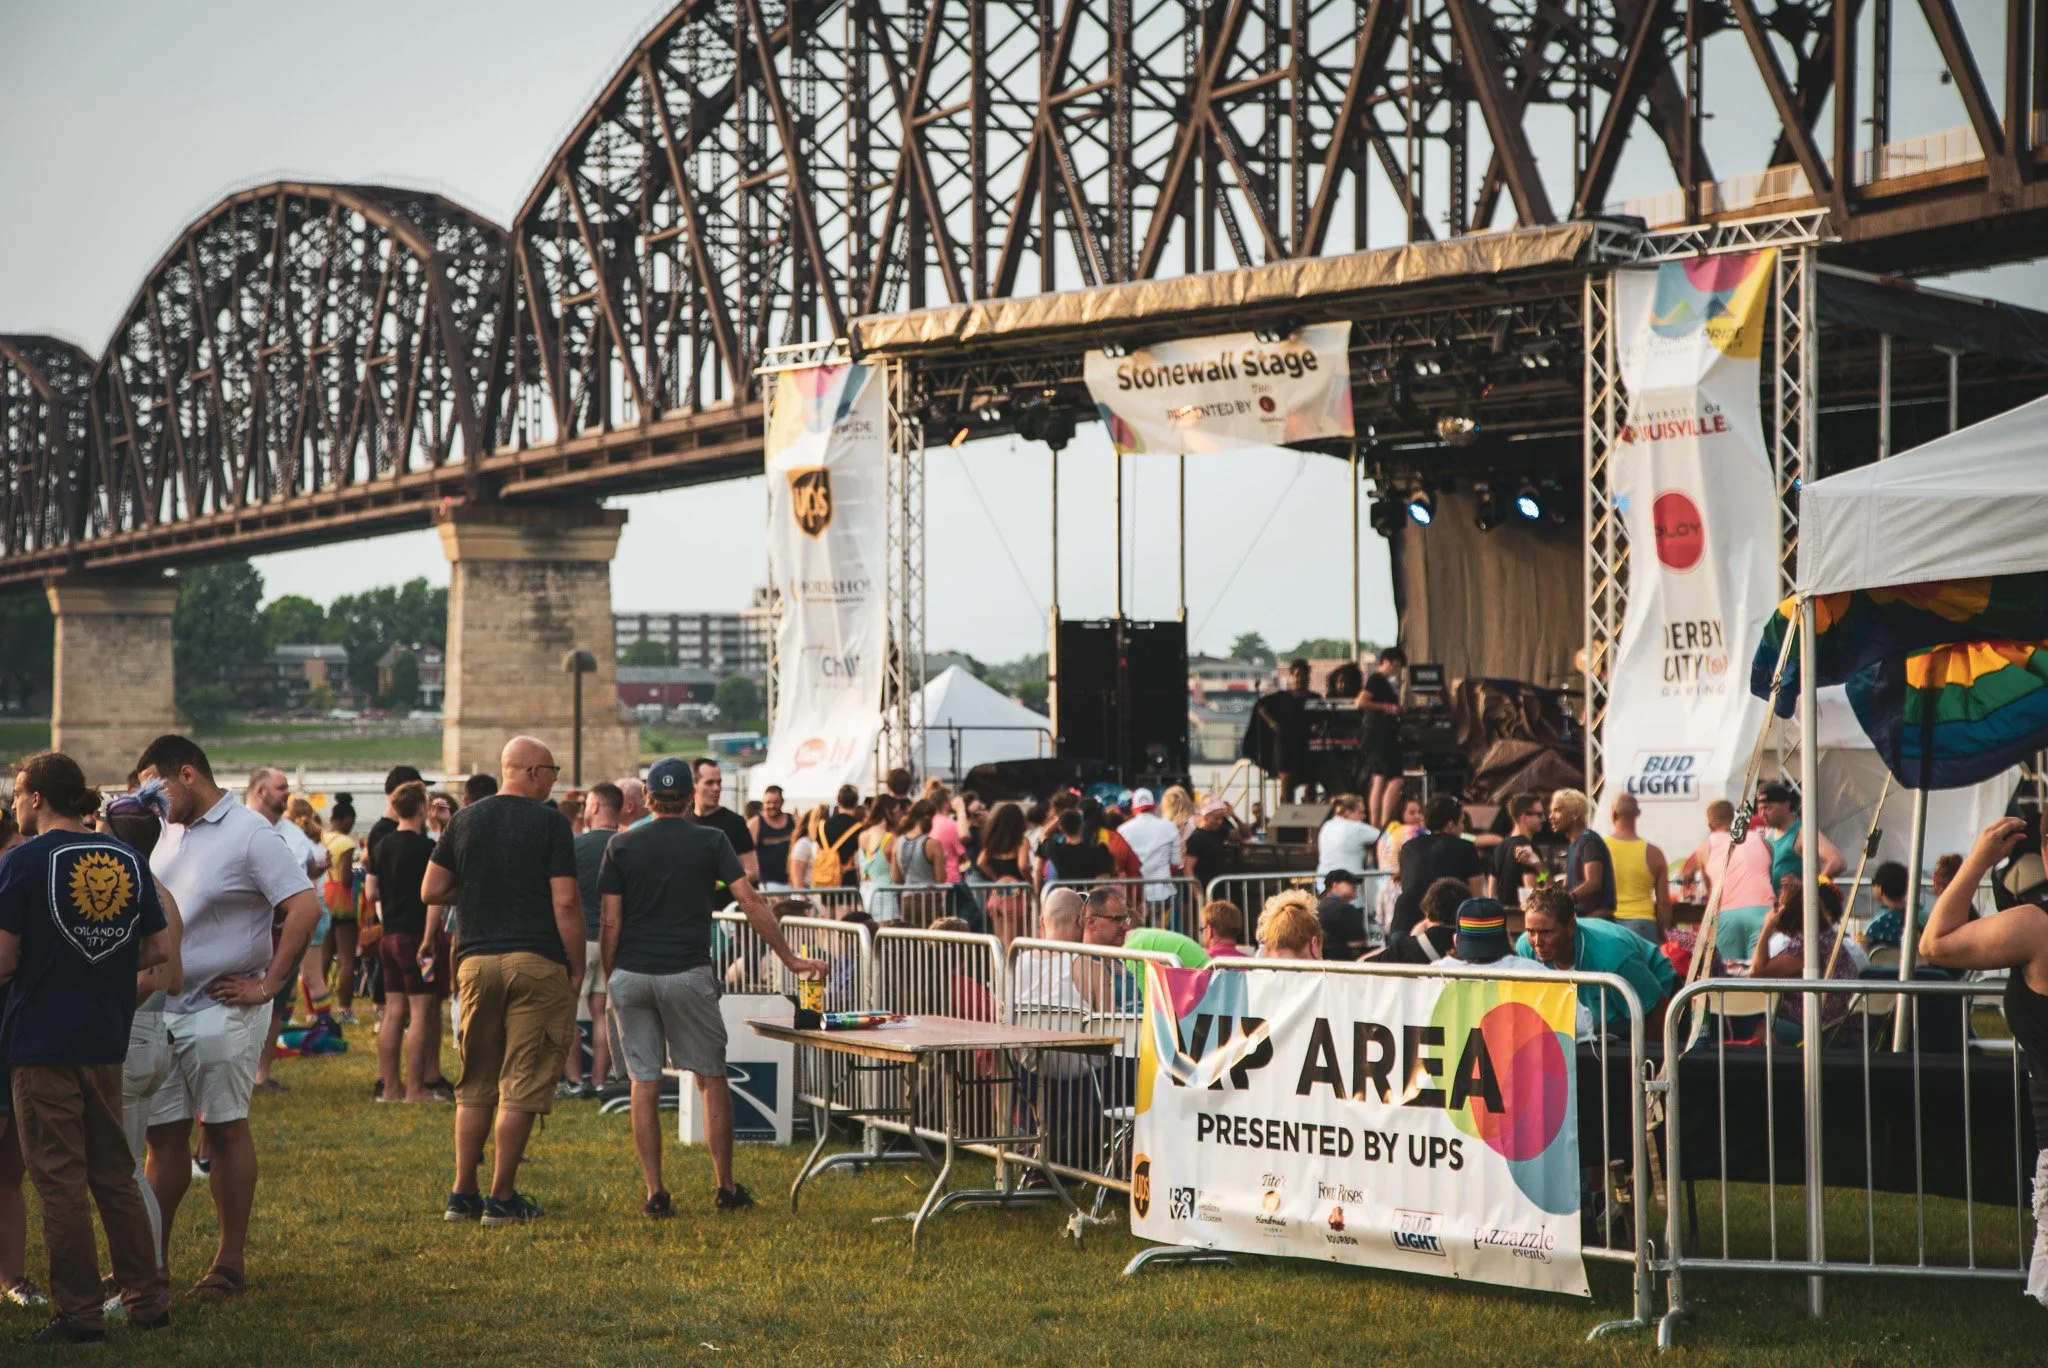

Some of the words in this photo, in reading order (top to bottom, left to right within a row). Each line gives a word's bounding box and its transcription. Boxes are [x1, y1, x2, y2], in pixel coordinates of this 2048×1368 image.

[1117, 351, 1237, 391] Stonewall
[1243, 347, 1318, 379] Stage
[1166, 402, 1234, 420] PRNTED
[1235, 400, 1252, 415] BY
[1663, 653, 1704, 682] CITY
[1661, 685, 1727, 697] GAMING
[1643, 755, 1695, 773] BUD
[1627, 774, 1697, 795] LIGHT
[87, 936, 108, 947] ITY
[1171, 1011, 1274, 1091] VIP
[1295, 1016, 1506, 1114] AREA
[1197, 1112, 1354, 1158] PRESENTED
[1364, 1130, 1401, 1165] BY
[1409, 1136, 1464, 1171] UPS
[1318, 1182, 1337, 1200] Four
[1338, 1184, 1364, 1205] Roses
[1400, 1214, 1431, 1233] BUD
[1394, 1231, 1440, 1252] LIGHT
[1474, 1225, 1554, 1252] pizzazzle
[1512, 1247, 1546, 1261] events
